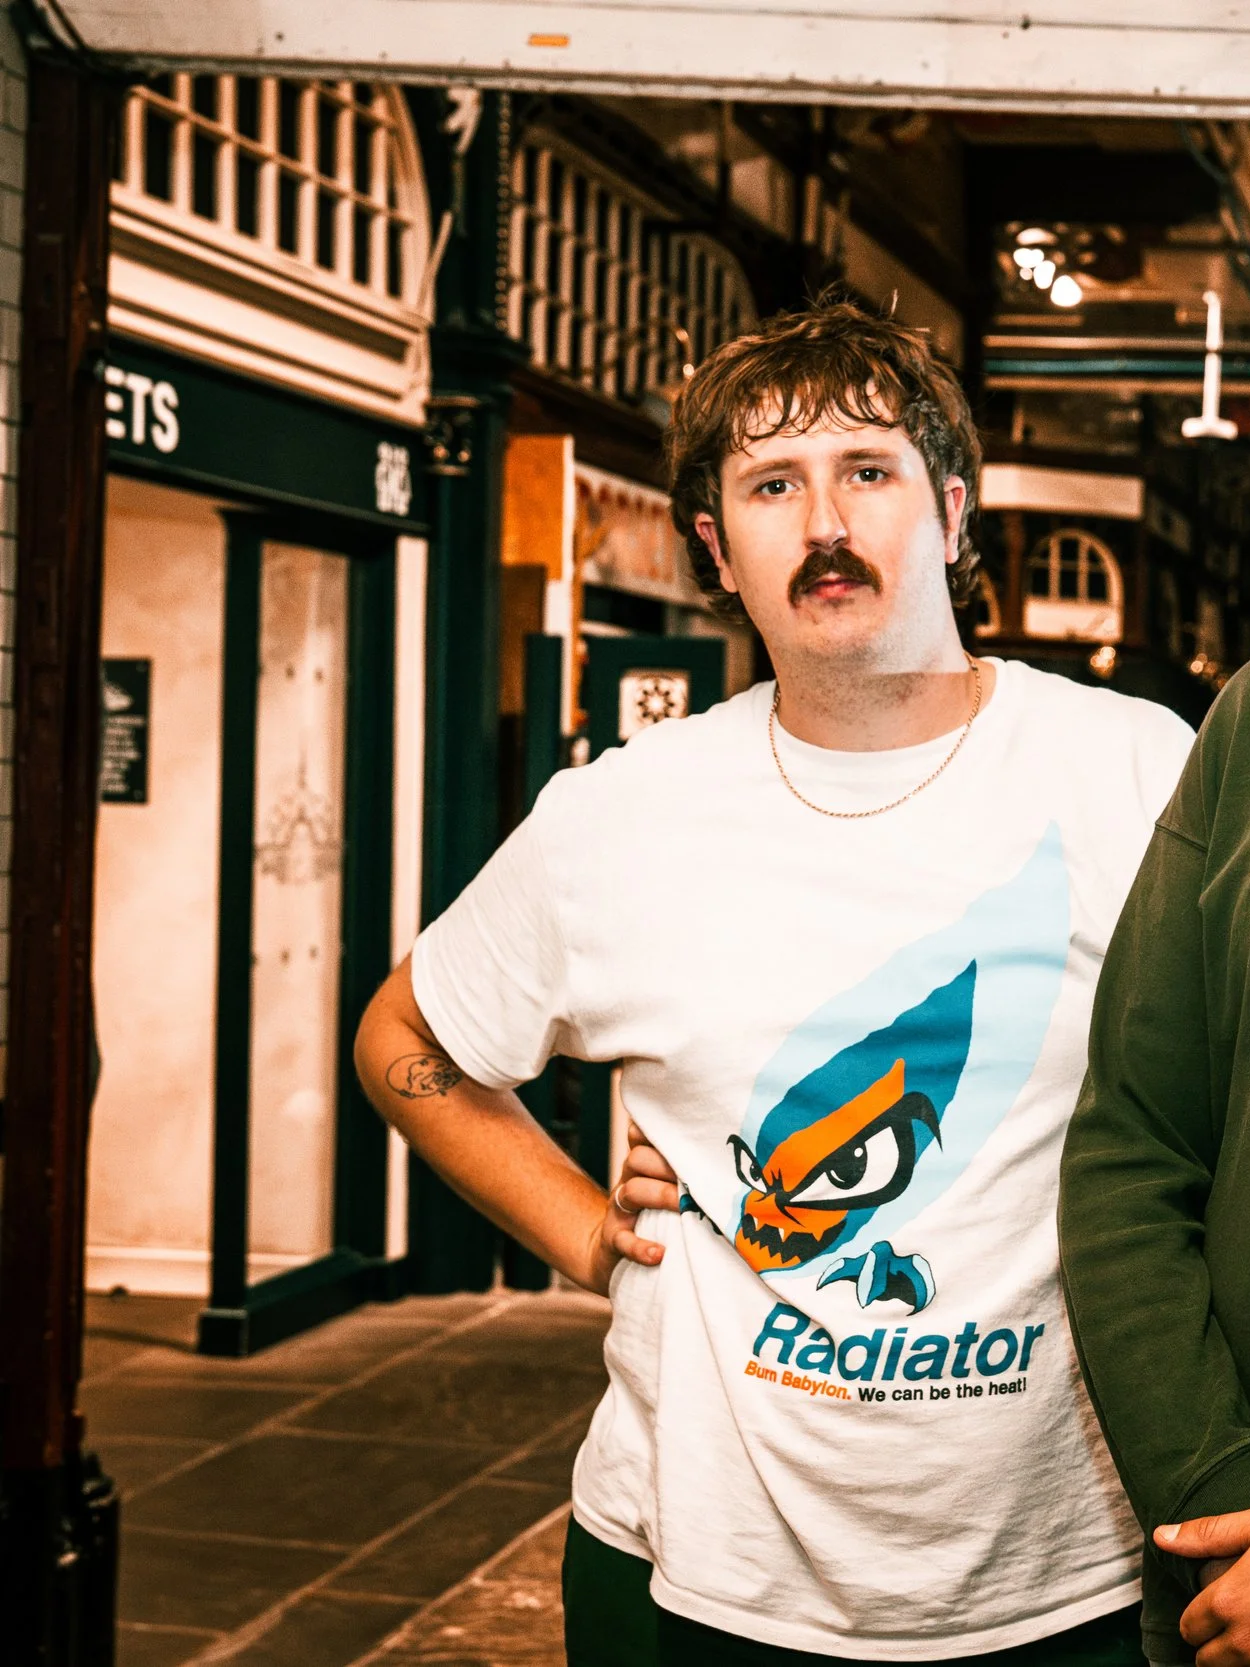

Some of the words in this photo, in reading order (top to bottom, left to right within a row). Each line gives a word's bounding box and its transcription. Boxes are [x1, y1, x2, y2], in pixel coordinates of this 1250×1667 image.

[752, 1301, 1046, 1382] Radiator
[744, 1360, 778, 1383] Burn
[780, 1370, 853, 1400] Babylon.
[858, 1387, 886, 1402] We
[891, 1388, 923, 1401] can
[929, 1385, 951, 1401] be
[956, 1383, 984, 1399] the
[988, 1377, 1027, 1396] heat!
